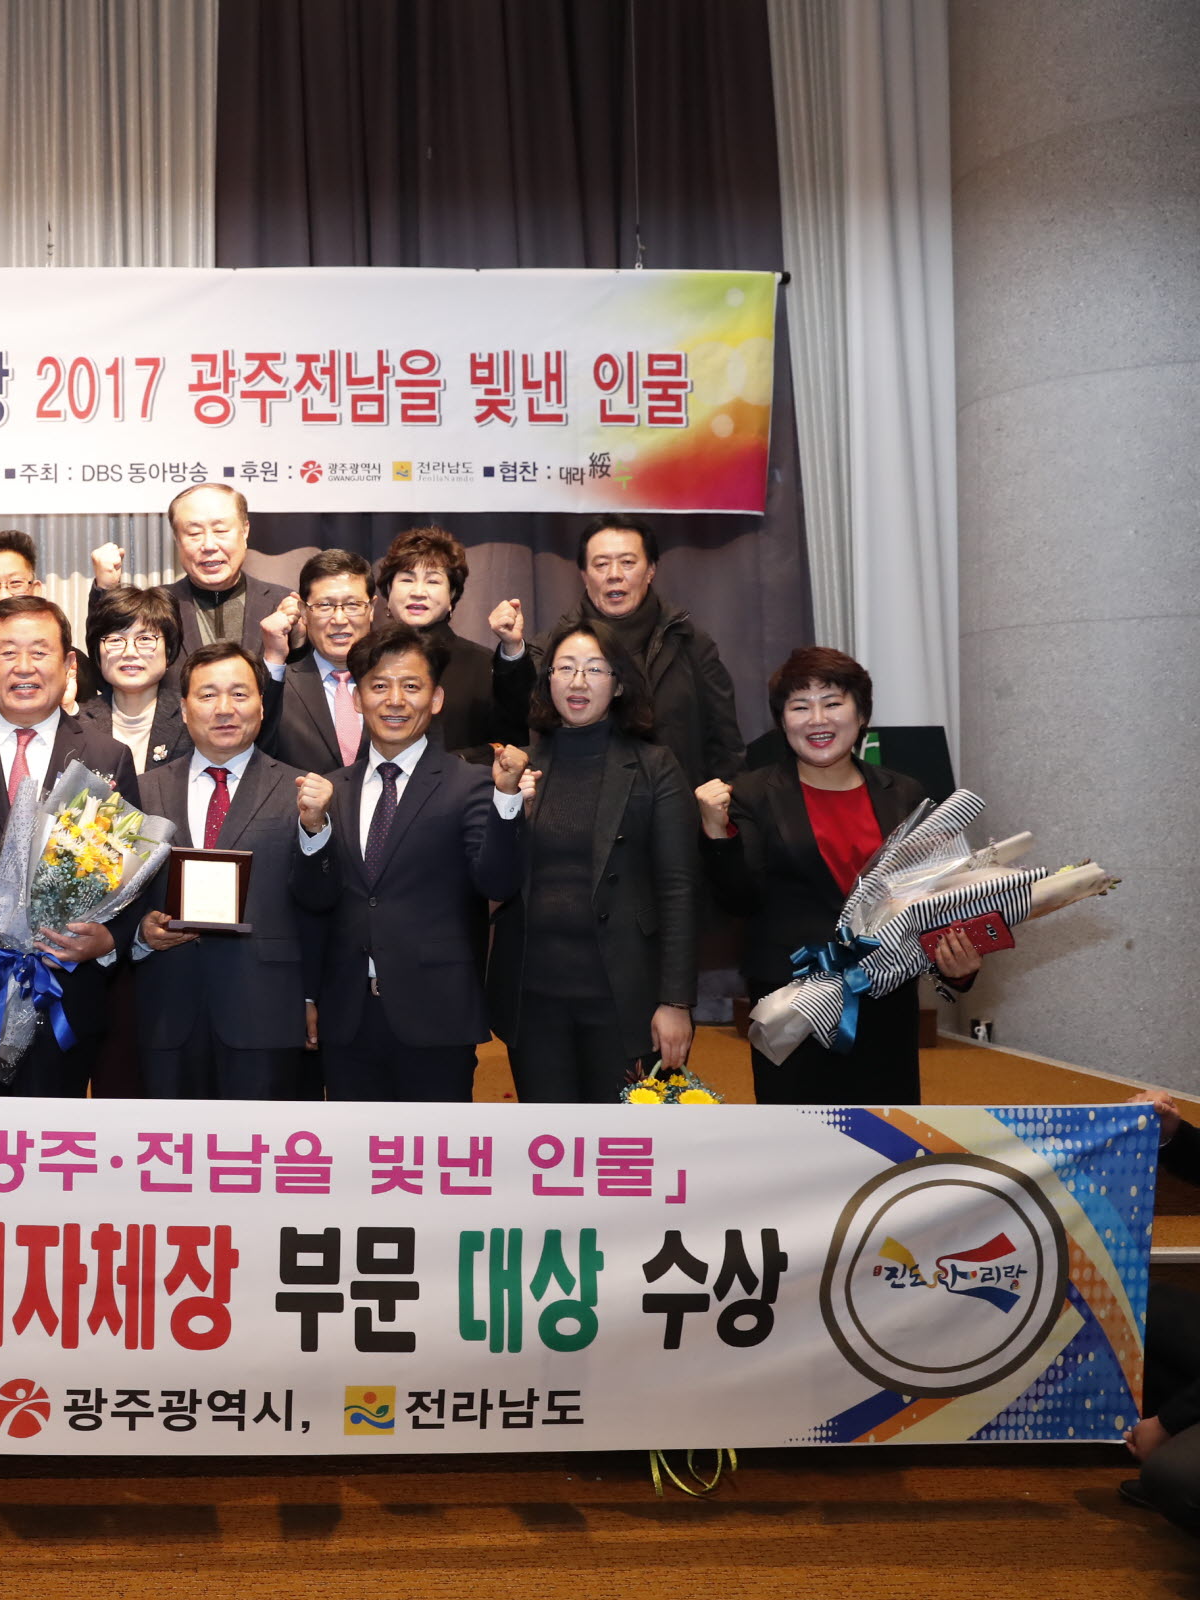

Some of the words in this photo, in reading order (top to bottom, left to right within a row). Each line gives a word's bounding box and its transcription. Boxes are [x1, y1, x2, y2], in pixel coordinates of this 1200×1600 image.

[36, 356, 164, 421] 2017
[188, 349, 447, 427] 광주전남을
[470, 350, 568, 427] 빛낸
[593, 351, 690, 429] 인물
[20, 464, 57, 483] 주최
[82, 464, 122, 482] DBS
[128, 462, 206, 483] 동아방송
[240, 461, 278, 482] 후원
[328, 463, 381, 474] 광주광역시
[418, 462, 474, 474] 전라남도
[499, 461, 538, 482] 협찬
[369, 1136, 492, 1195] 빛낸
[275, 1227, 419, 1353] 부문
[459, 1228, 604, 1353] 대상
[643, 1228, 789, 1350] 수상
[64, 1388, 310, 1434] 광주광역시,
[405, 1388, 584, 1429] 전라남도
